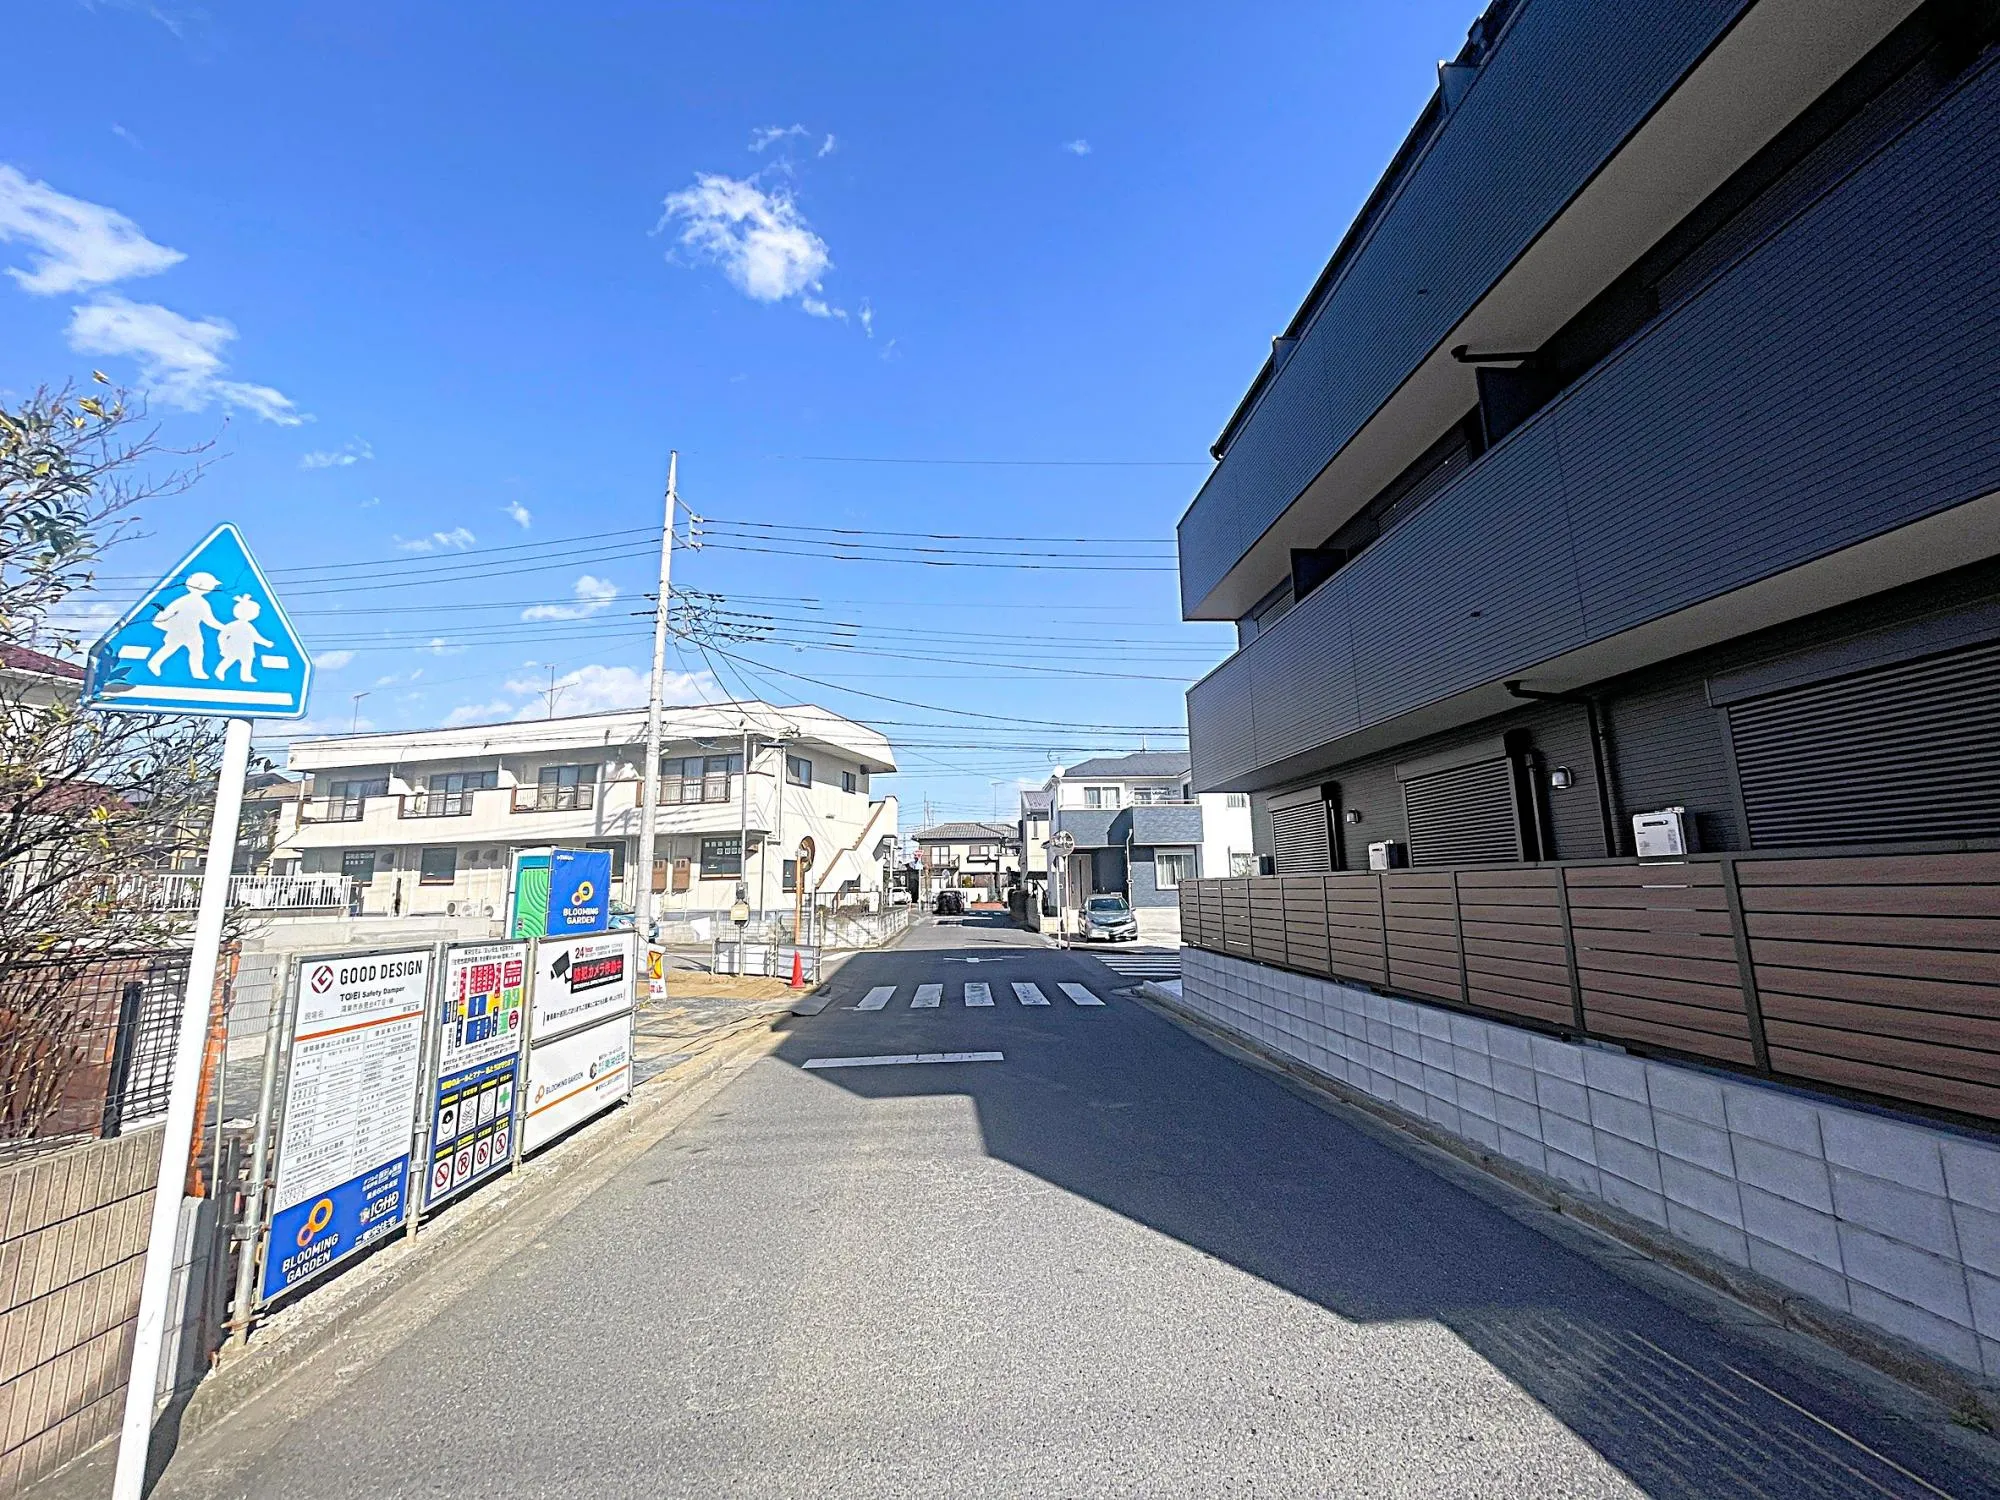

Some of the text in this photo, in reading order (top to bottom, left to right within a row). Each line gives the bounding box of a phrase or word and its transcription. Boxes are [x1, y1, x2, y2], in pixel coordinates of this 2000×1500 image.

[563, 908, 599, 916] BLOOMING
[566, 916, 596, 924] GARDEN
[575, 947, 585, 959] 24
[340, 959, 423, 985] GOOD DESIGN
[362, 989, 382, 999] Safety
[383, 986, 405, 996] Damper
[546, 1079, 568, 1095] BLOOMING
[282, 1233, 339, 1273] BLOOMING
[287, 1250, 331, 1283] GARDEN
